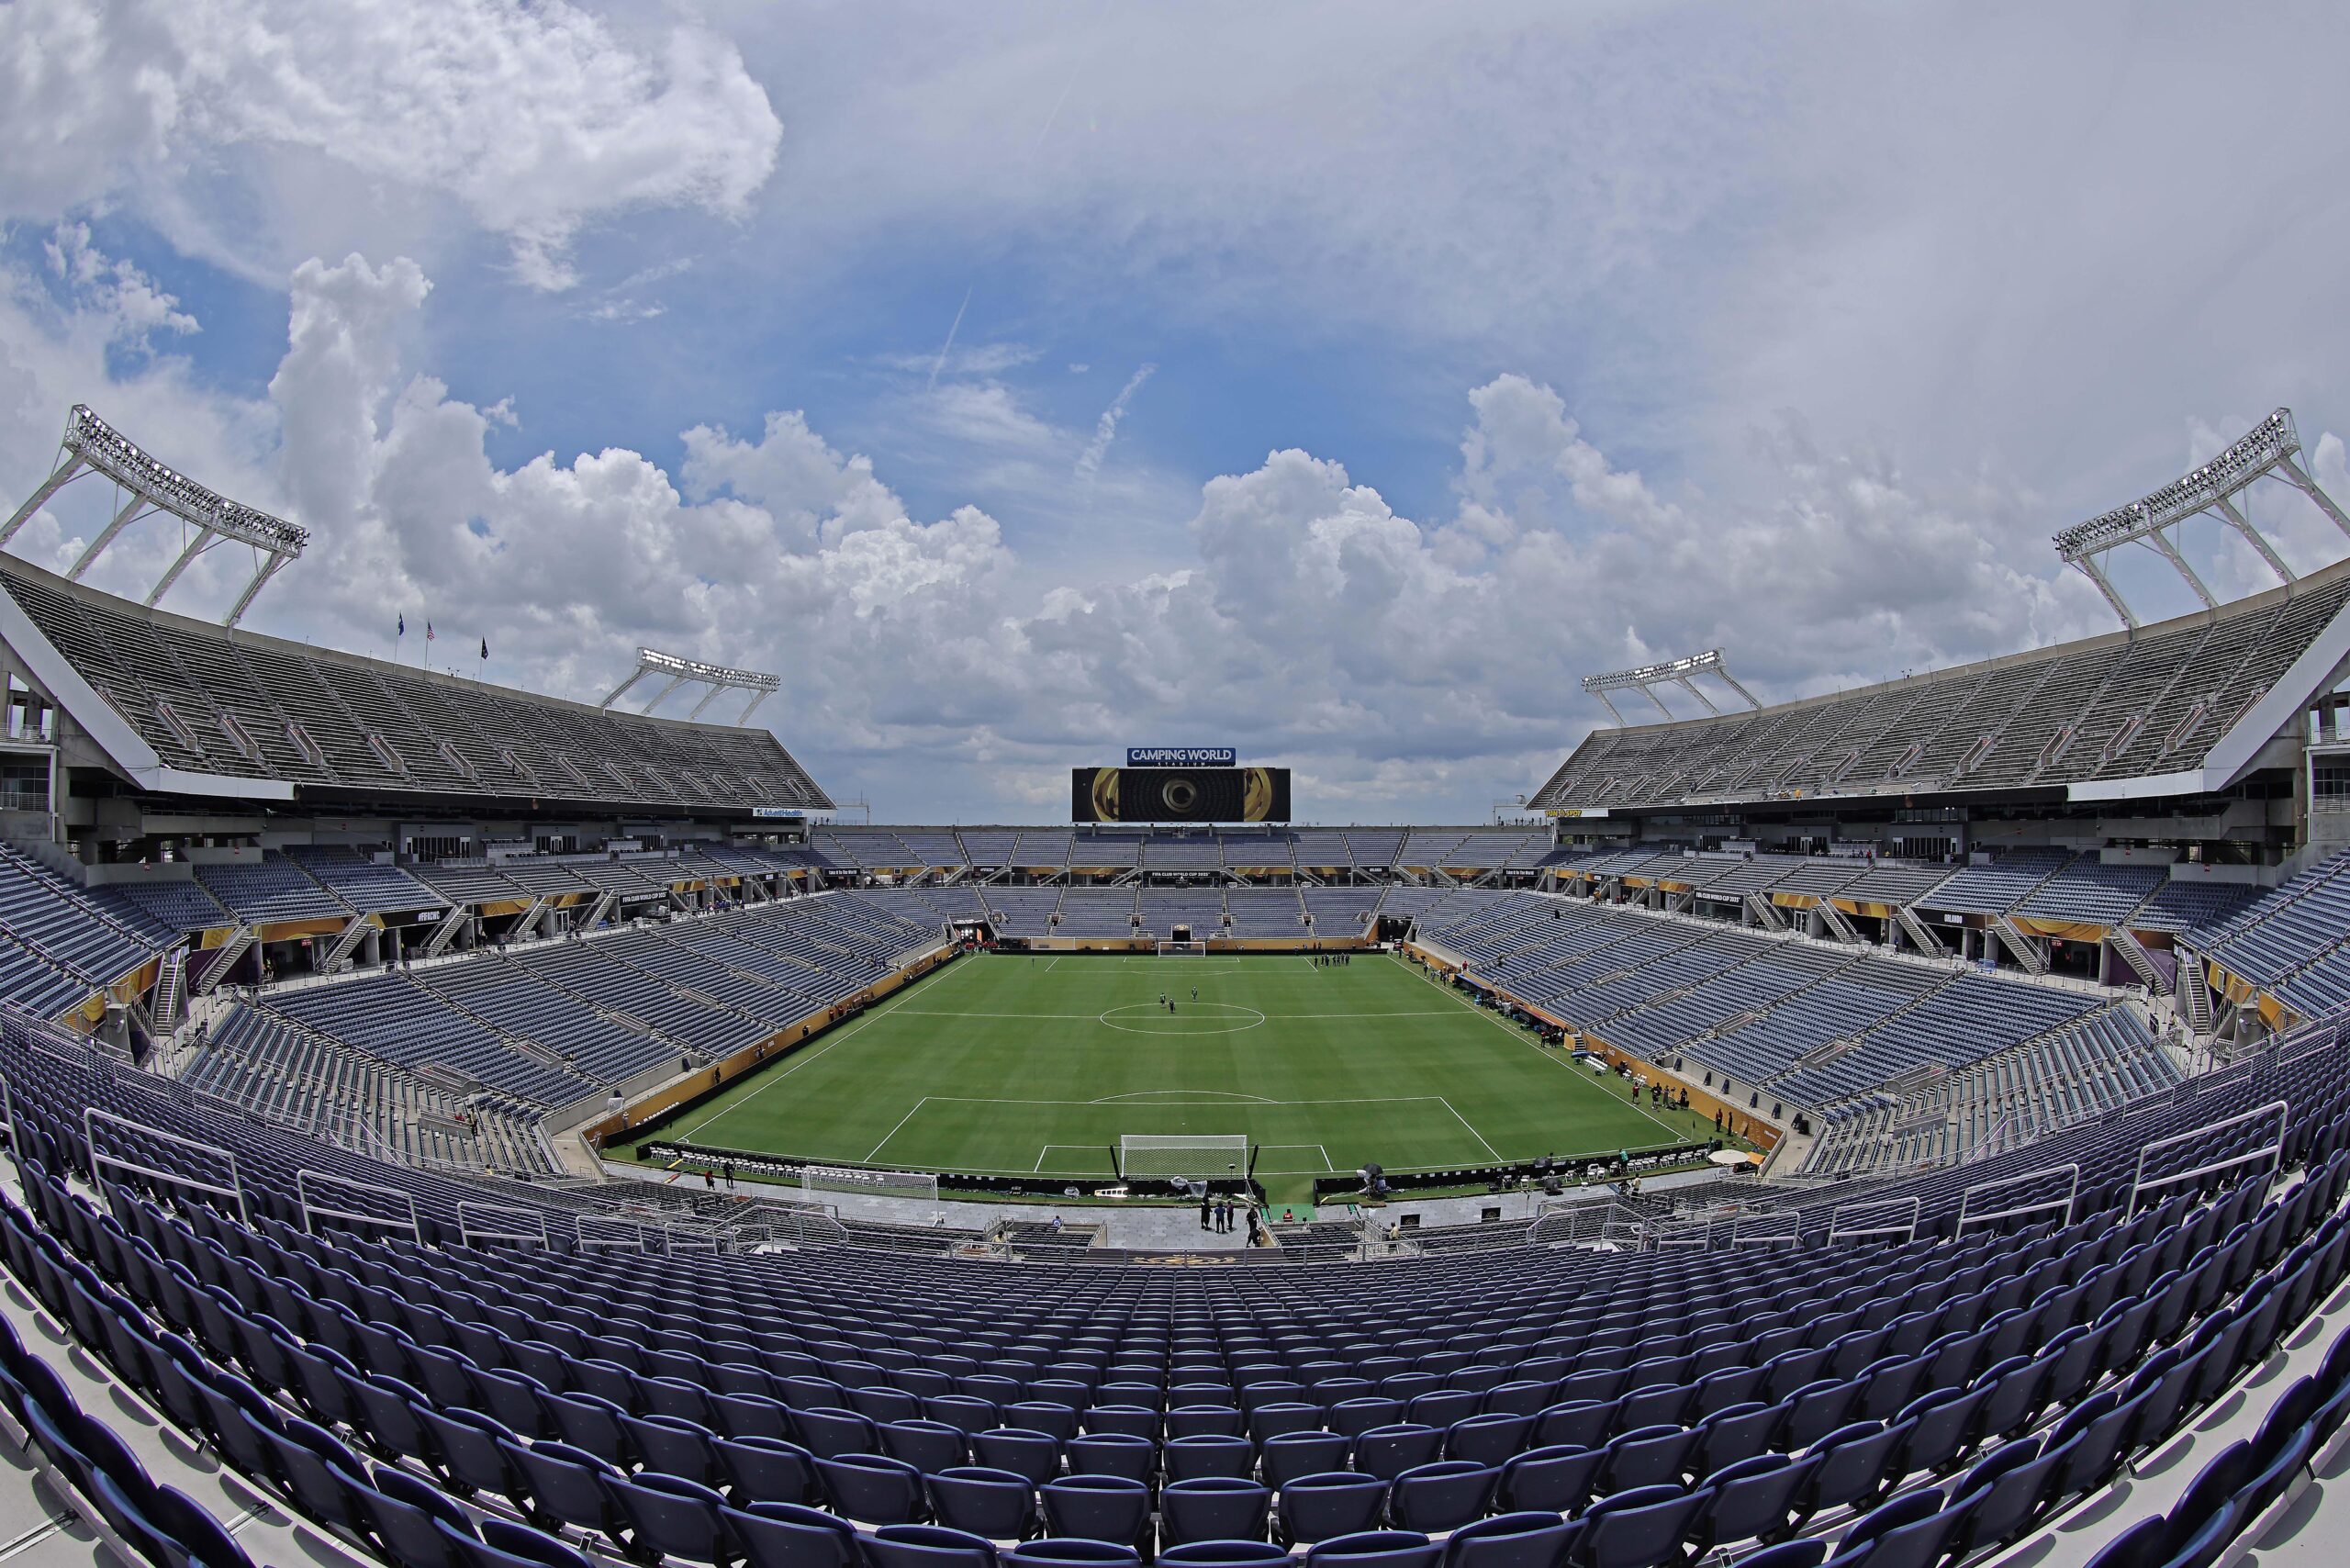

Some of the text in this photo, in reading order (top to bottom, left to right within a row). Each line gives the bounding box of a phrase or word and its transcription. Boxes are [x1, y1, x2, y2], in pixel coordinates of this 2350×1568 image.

[1131, 749, 1232, 760] CAMPING WORLD
[1944, 913, 1963, 924] ORLANDO
